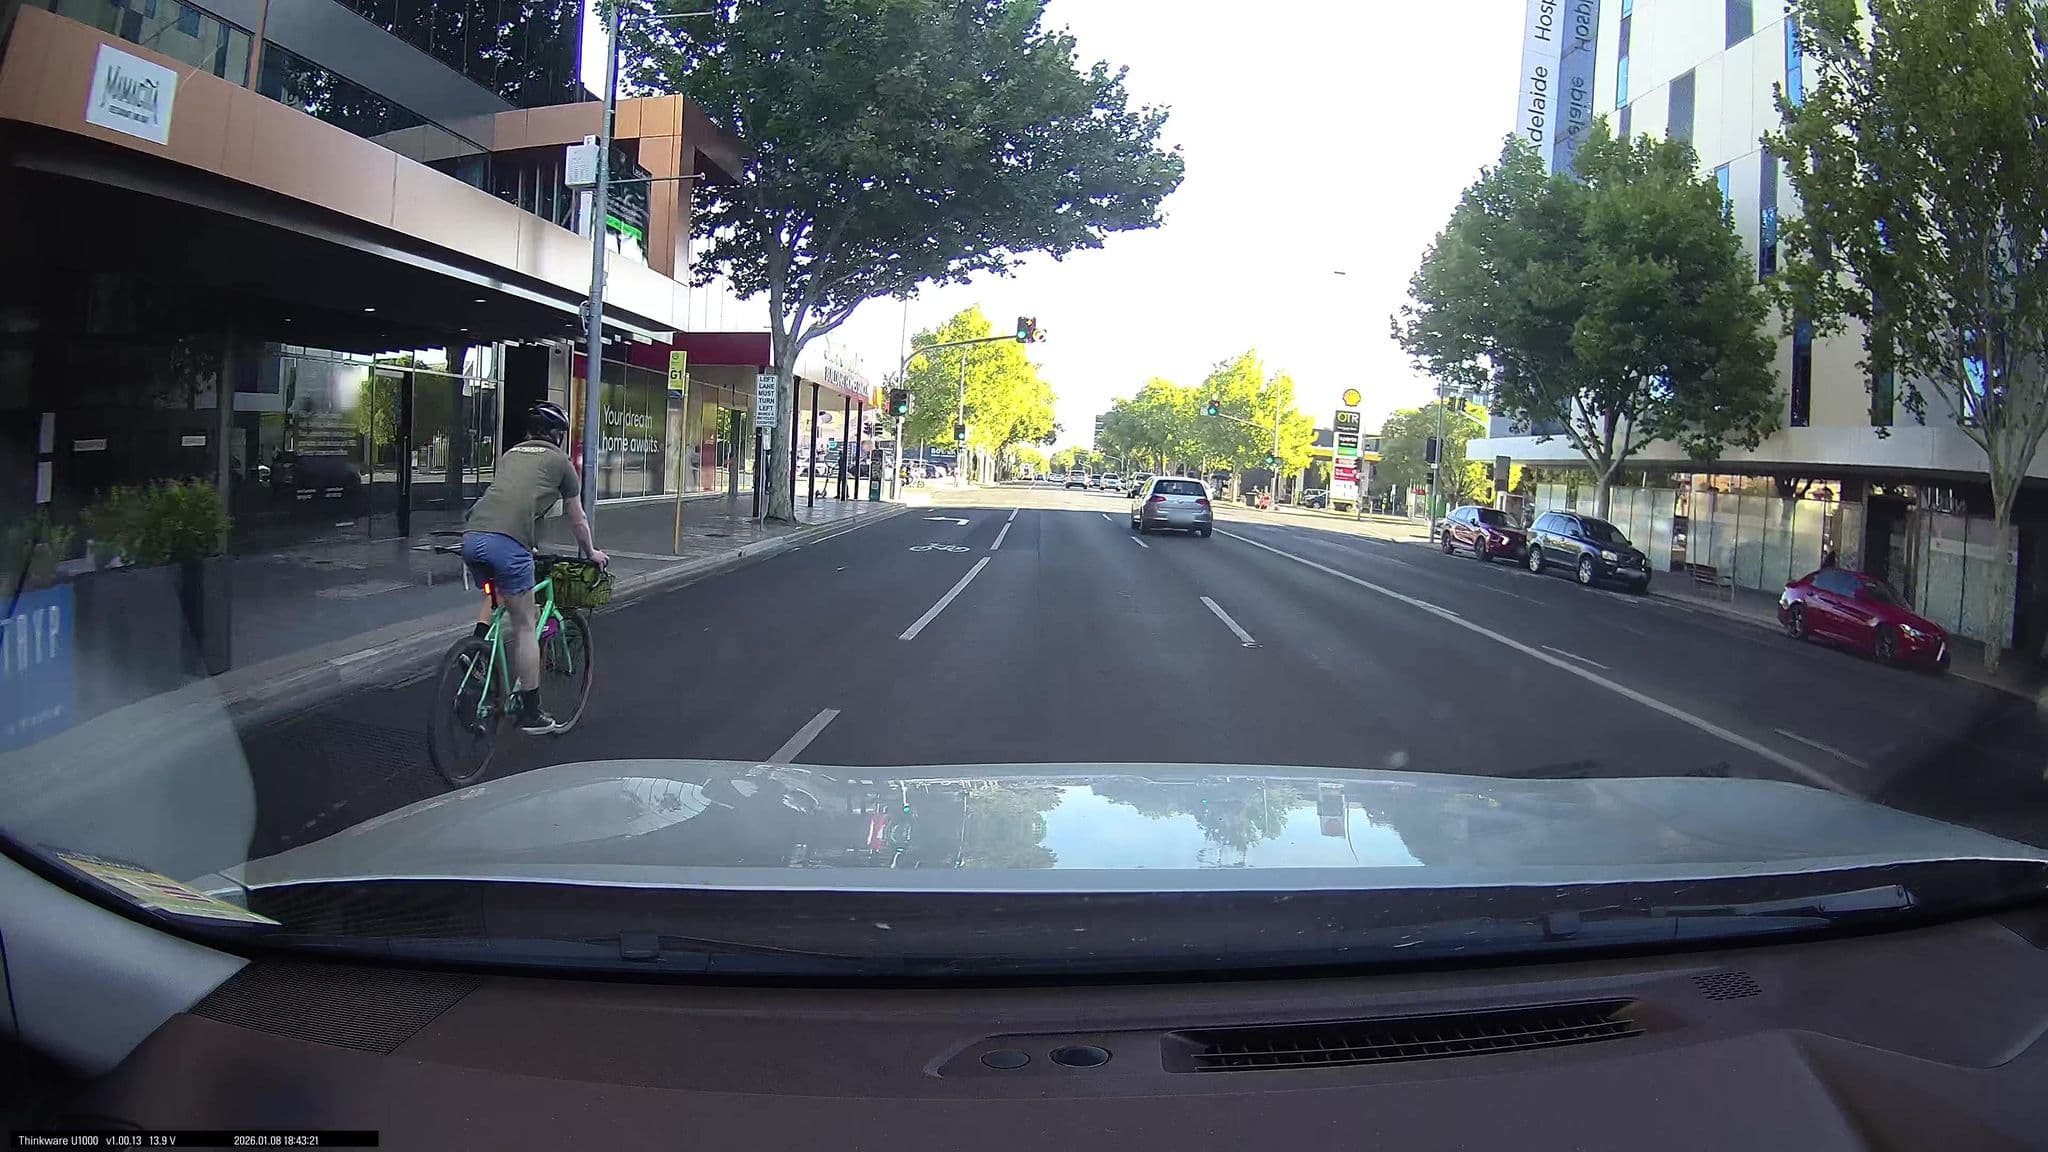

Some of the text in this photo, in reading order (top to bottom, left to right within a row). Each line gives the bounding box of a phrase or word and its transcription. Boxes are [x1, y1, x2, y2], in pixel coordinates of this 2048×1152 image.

[670, 370, 682, 380] G1
[603, 404, 653, 429] Your dream
[1337, 412, 1359, 423] OTR
[602, 430, 629, 452] home
